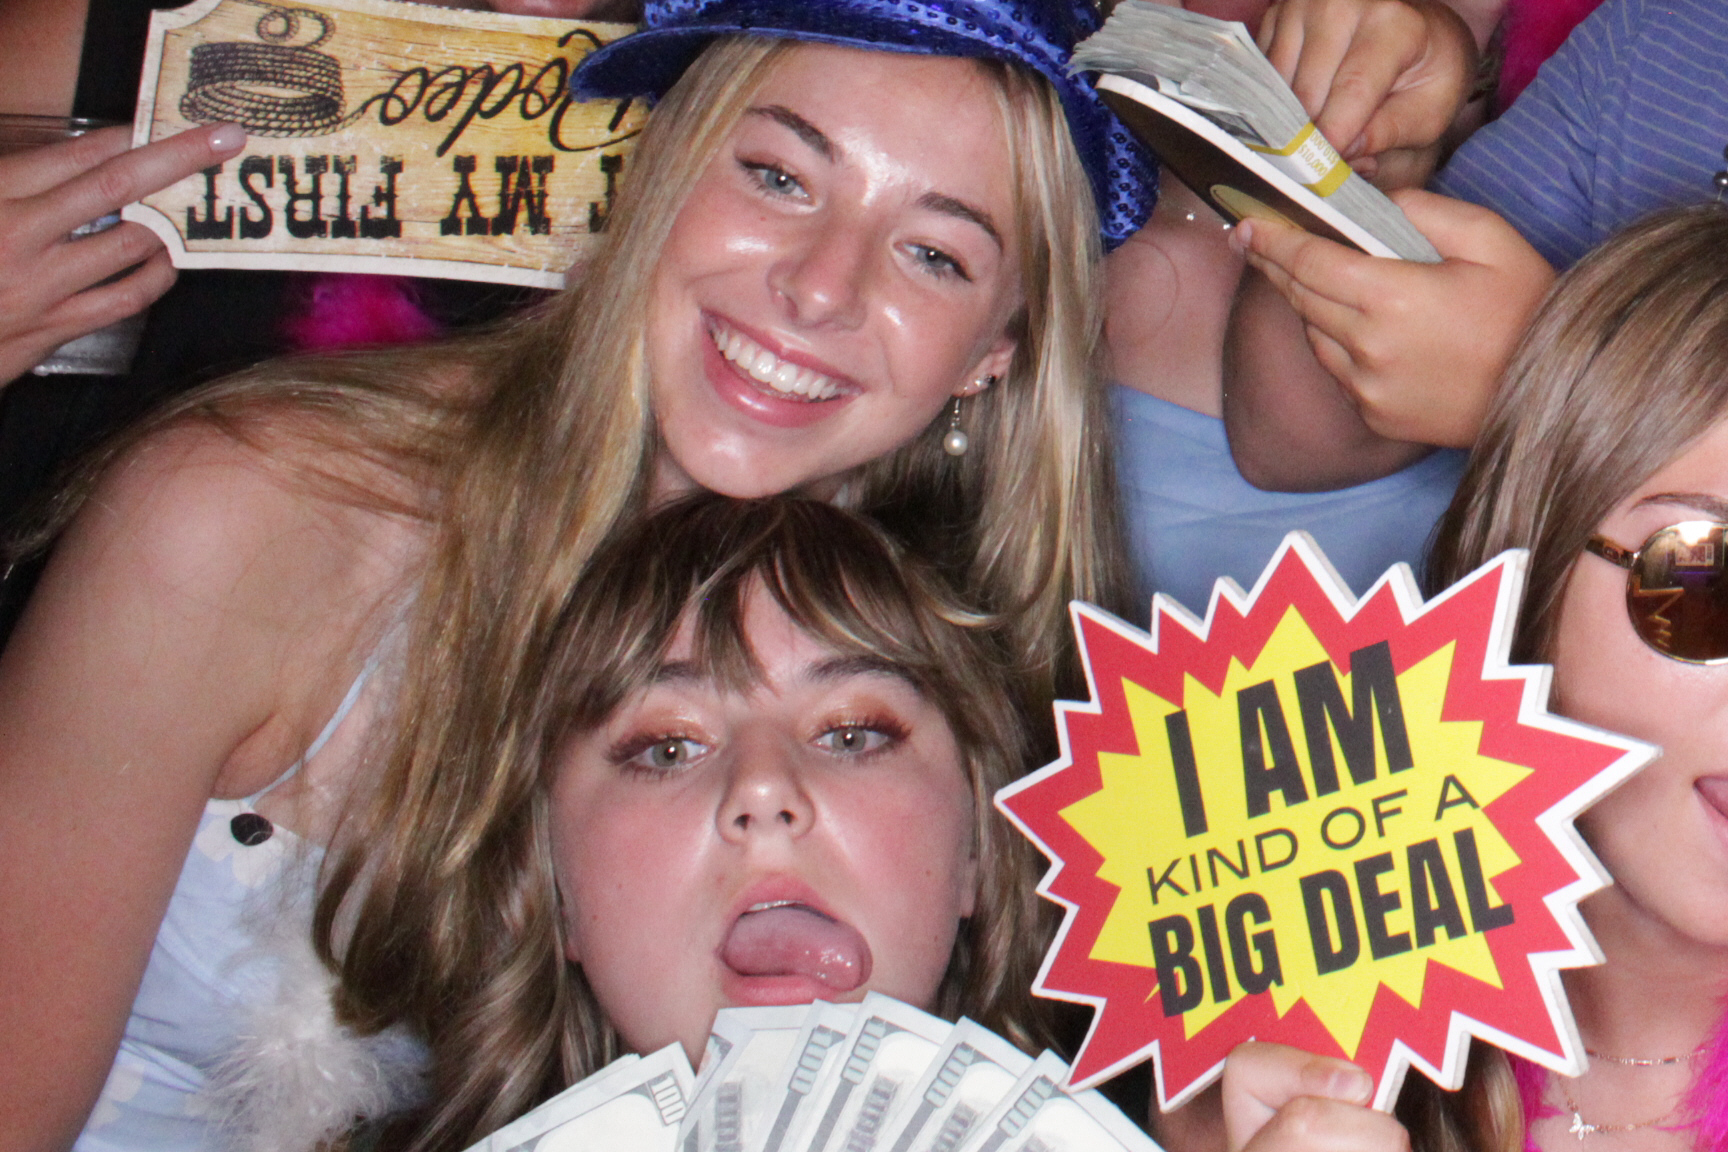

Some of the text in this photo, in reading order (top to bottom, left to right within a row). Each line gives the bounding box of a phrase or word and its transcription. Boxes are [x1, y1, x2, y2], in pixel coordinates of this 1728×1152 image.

[187, 154, 404, 240] FIRST
[440, 155, 555, 236] MY
[1164, 639, 1415, 839] I AM
[1147, 773, 1480, 904] KIND OF A
[1147, 827, 1515, 1018] BIG DEAL
